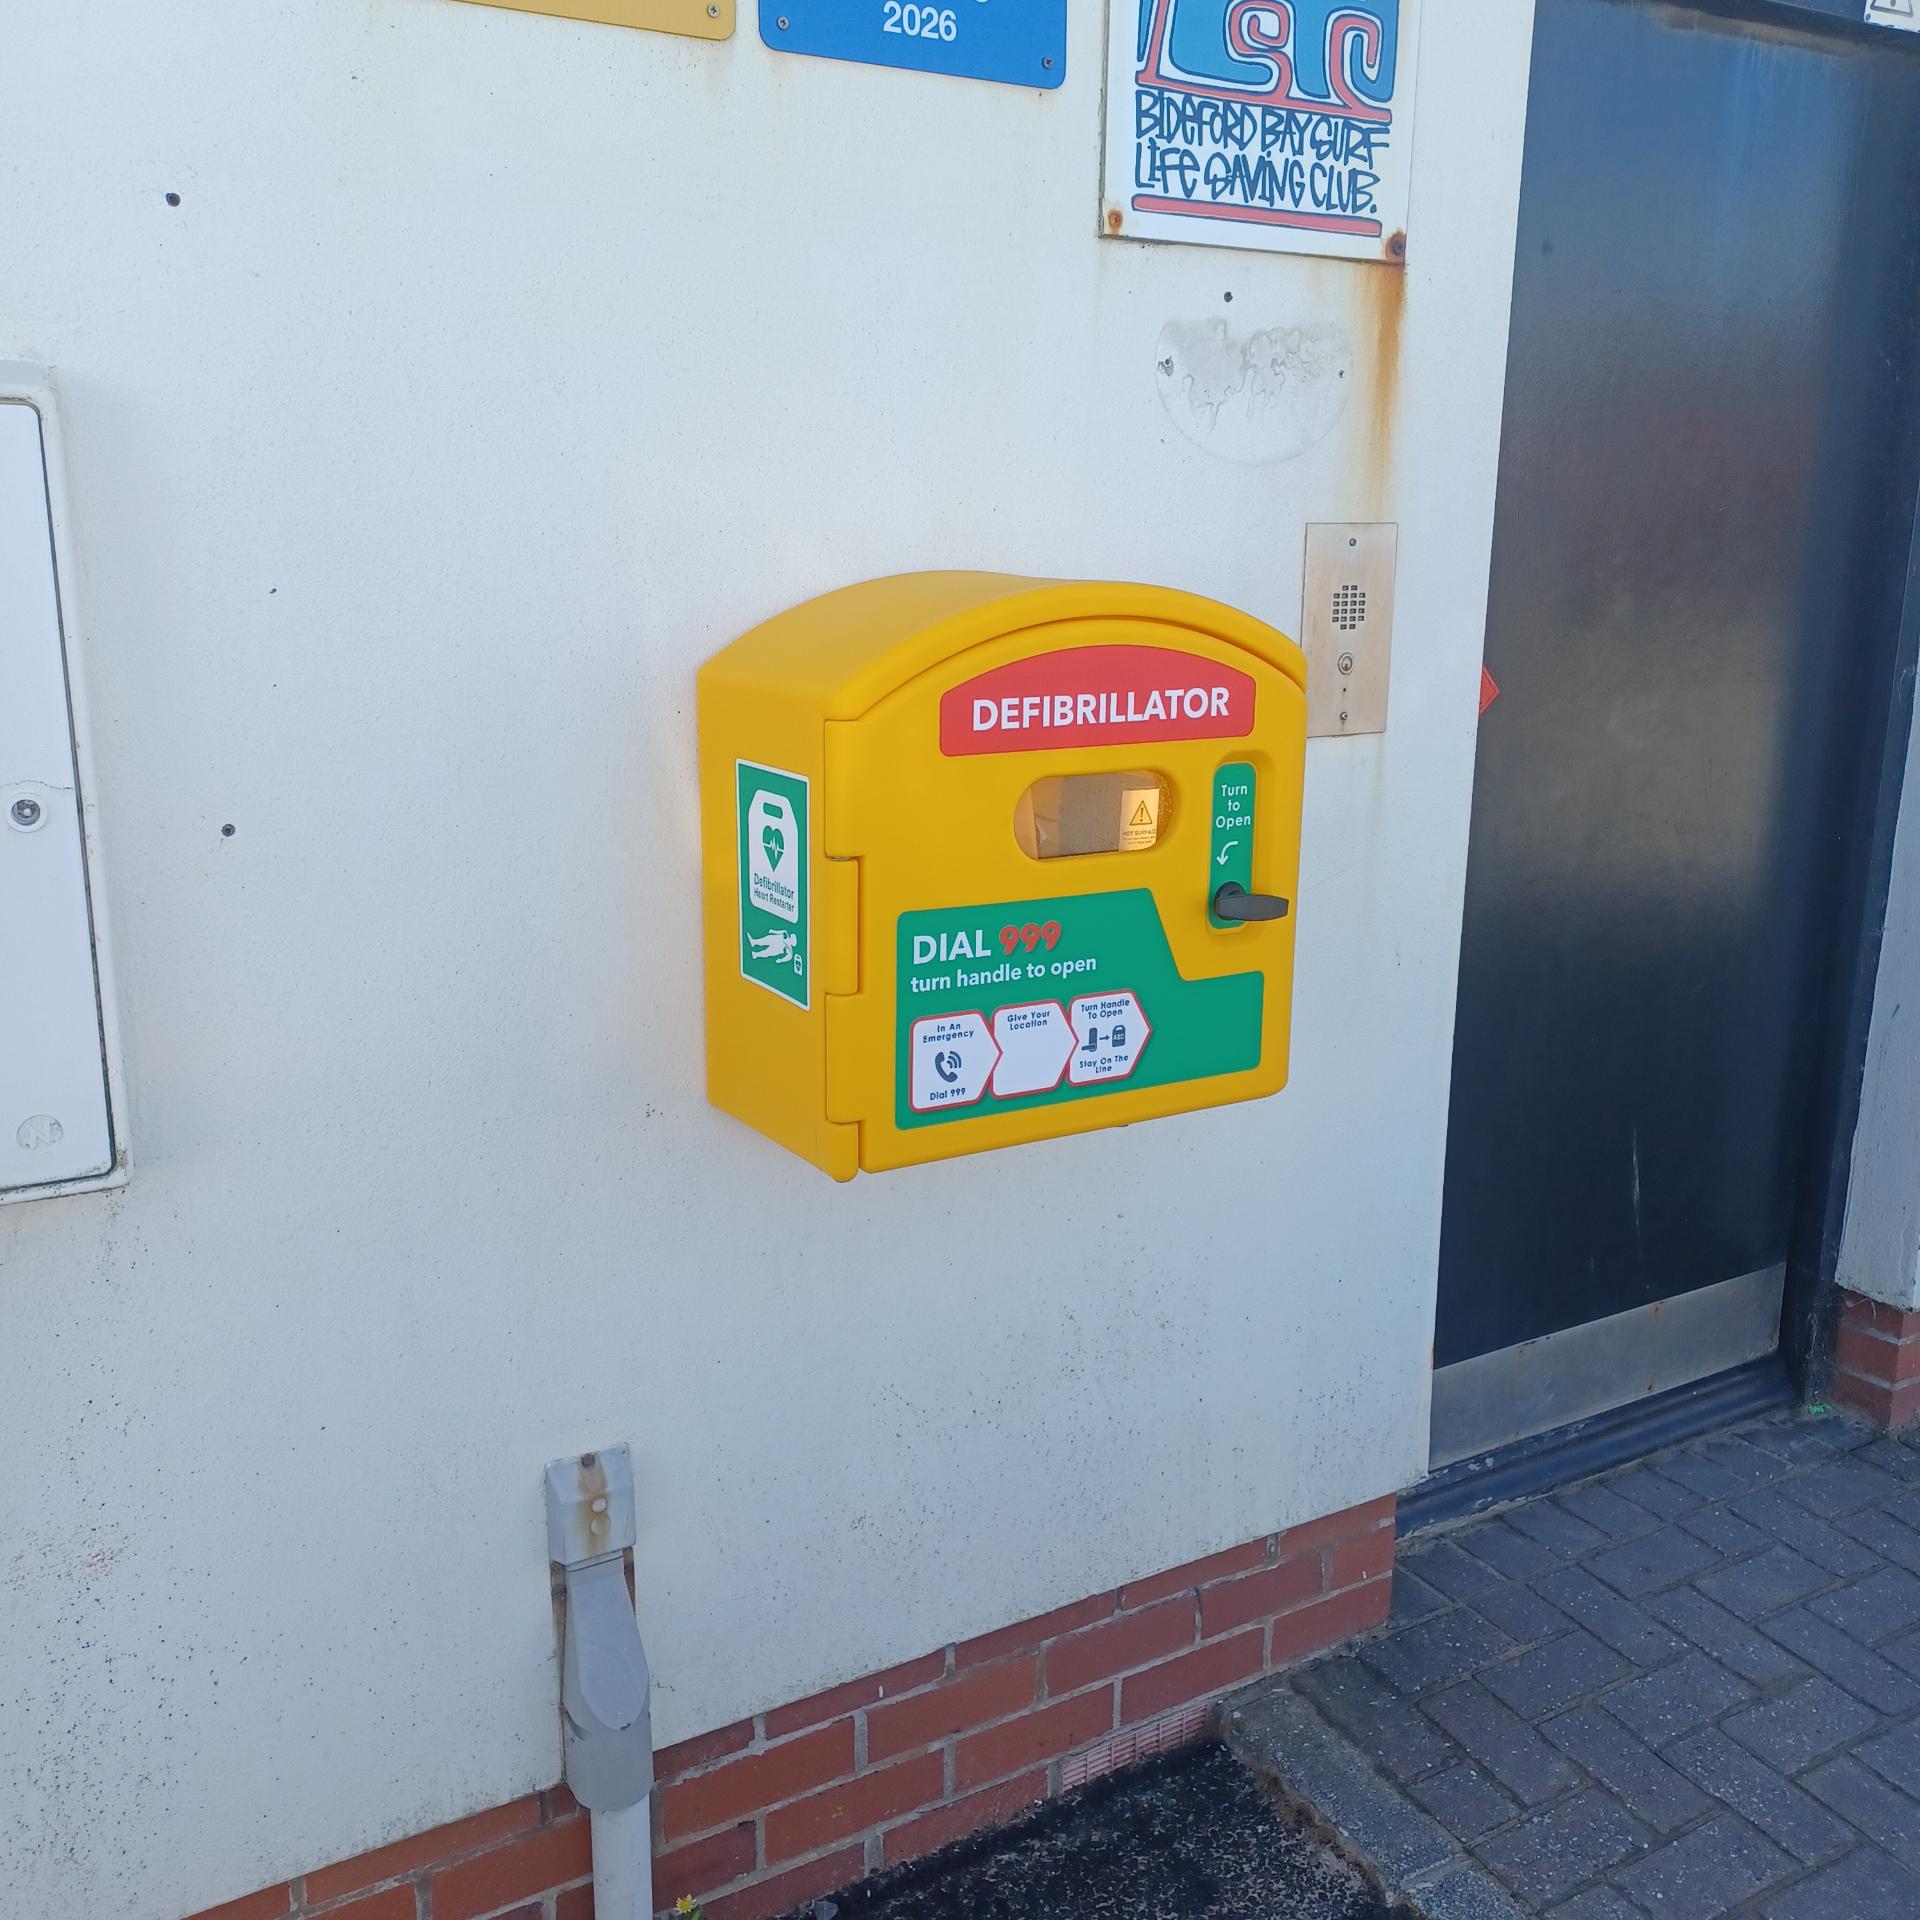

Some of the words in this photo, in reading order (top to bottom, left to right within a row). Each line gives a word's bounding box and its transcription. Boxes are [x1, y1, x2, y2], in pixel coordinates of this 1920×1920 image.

[883, 0, 957, 42] 2026
[1261, 106, 1313, 156] BAY
[1309, 114, 1390, 170] SURF
[1309, 162, 1380, 214] CLUB.
[973, 687, 1229, 731] DEFIBRILLATOR
[1221, 784, 1248, 797] Turn
[1227, 799, 1240, 812] to
[1215, 815, 1251, 831] Open
[754, 873, 794, 899] Defibrillator
[770, 893, 794, 912] Restarter
[913, 929, 992, 965] DIAL
[998, 919, 1062, 956] 999
[910, 976, 950, 993] turn
[956, 962, 1022, 988] handle
[1026, 963, 1046, 979] to
[1050, 957, 1097, 979] open
[1081, 1003, 1098, 1013] Turn
[1100, 998, 1130, 1009] Handle
[1007, 1013, 1028, 1023] Give
[1030, 1010, 1050, 1020] Your
[1087, 1011, 1097, 1020] To
[1099, 1009, 1123, 1019] Open
[936, 1024, 946, 1033] In
[949, 1023, 961, 1031] An
[1009, 1019, 1048, 1031] Location
[923, 1029, 975, 1044] Emergency
[1079, 1060, 1098, 1069] Stay
[1100, 1057, 1112, 1065] On
[1095, 1065, 1112, 1074] Line
[929, 1090, 948, 1101] Dial
[950, 1087, 966, 1098] 999
